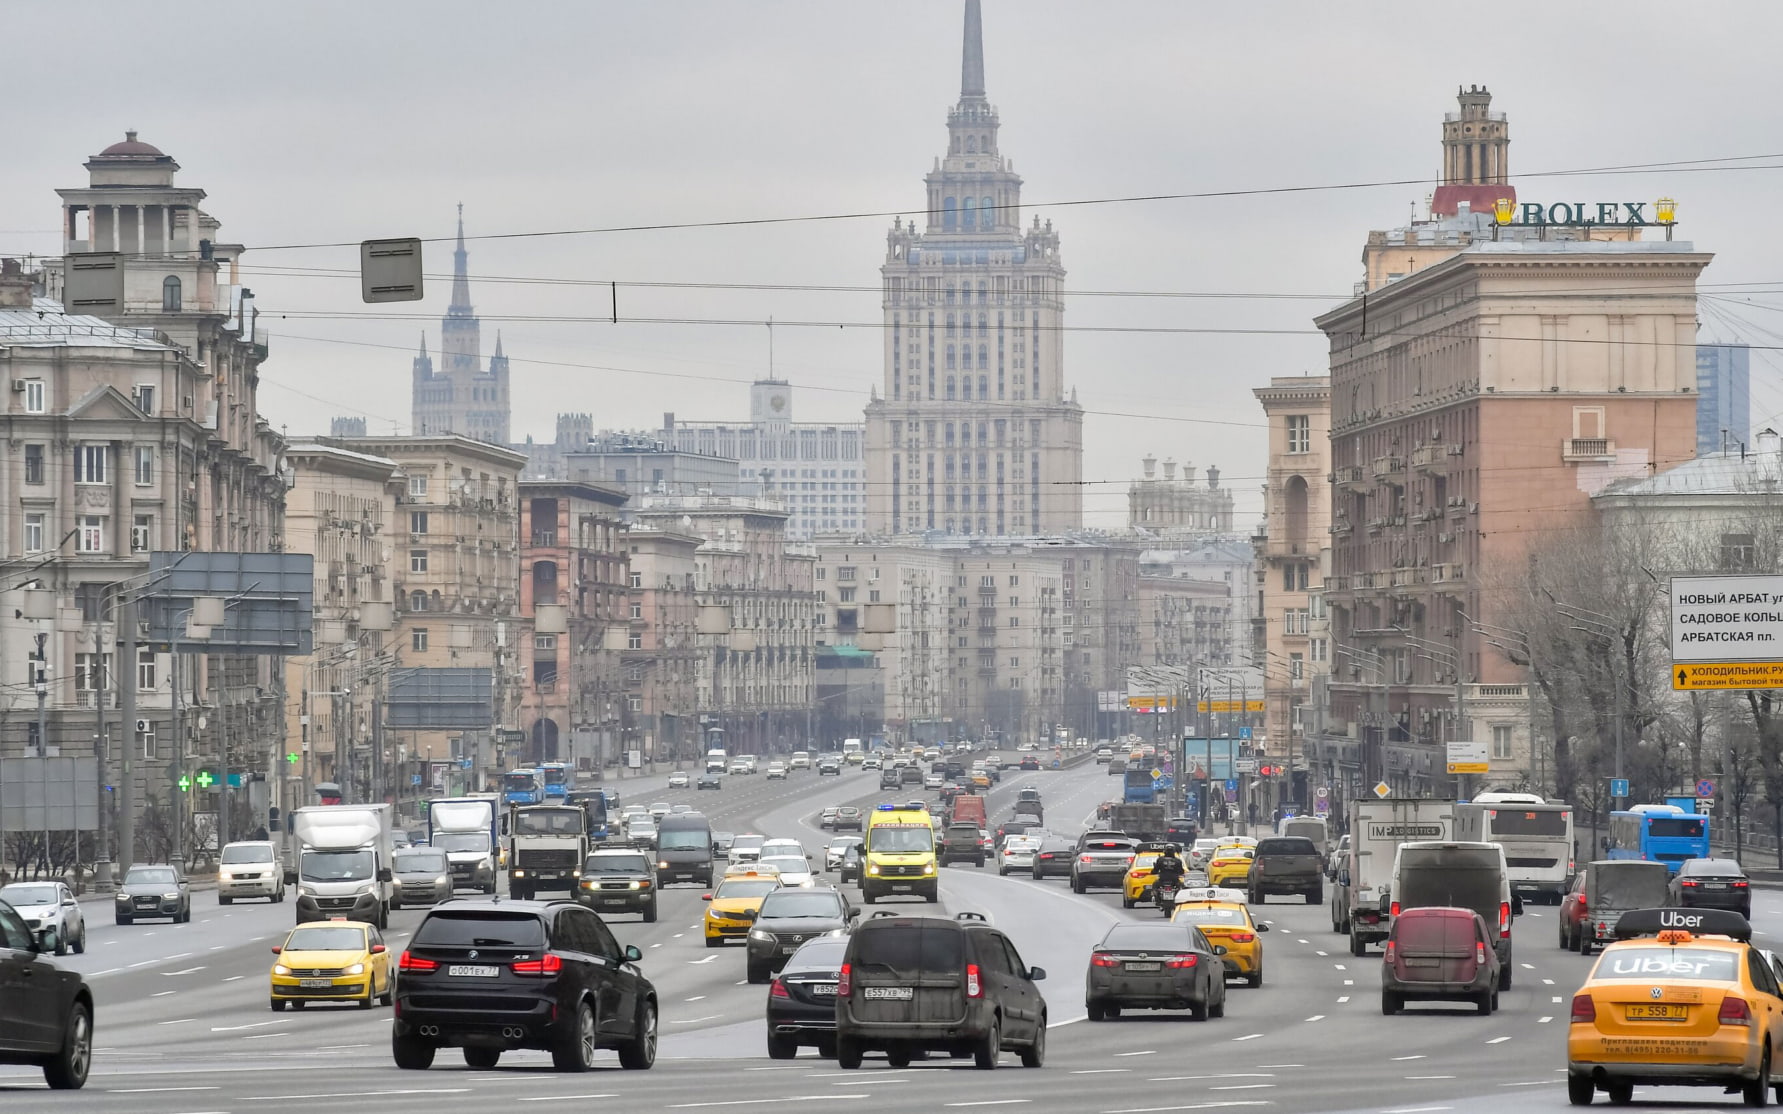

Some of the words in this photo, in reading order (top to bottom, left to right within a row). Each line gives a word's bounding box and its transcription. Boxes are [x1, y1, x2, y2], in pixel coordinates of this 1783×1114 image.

[1520, 202, 1647, 225] ROLEX
[1679, 592, 1726, 604] НОВЫЙ
[1729, 593, 1769, 604] АРБАТ
[1680, 612, 1741, 624] САДОВОЕ
[1681, 631, 1754, 642] АРБАТСКАЯ
[1757, 633, 1776, 641] пл.
[1729, 677, 1767, 685] бытовой
[1372, 826, 1393, 836] IMP
[1395, 827, 1437, 835] LOGISTICS
[1660, 911, 1704, 928] Uber
[1613, 957, 1711, 975] Uber
[1648, 1006, 1668, 1016] 558
[1674, 1006, 1684, 1017] 77
